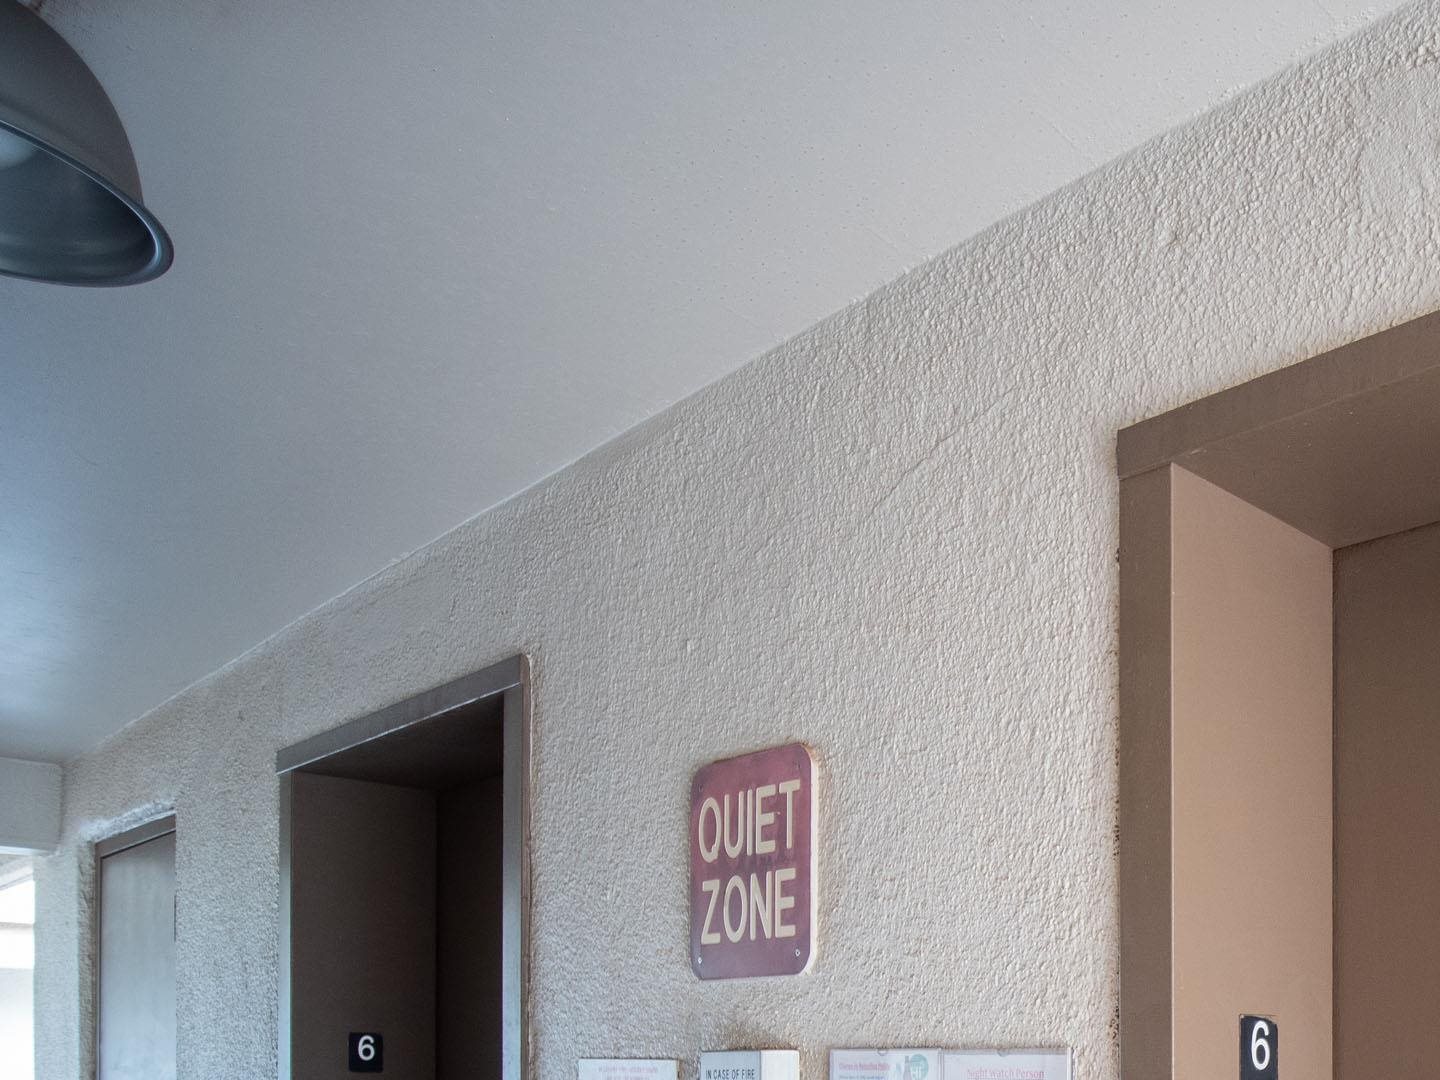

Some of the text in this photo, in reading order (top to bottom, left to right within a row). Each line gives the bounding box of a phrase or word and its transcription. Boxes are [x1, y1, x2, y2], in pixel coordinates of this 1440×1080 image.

[699, 779, 800, 863] QUIET
[701, 867, 796, 945] ZONE
[358, 1035, 375, 1061] 6
[1251, 1020, 1270, 1070] 6
[705, 1069, 755, 1080] IN CASE OF FIRE
[1016, 1068, 1045, 1080] Person
